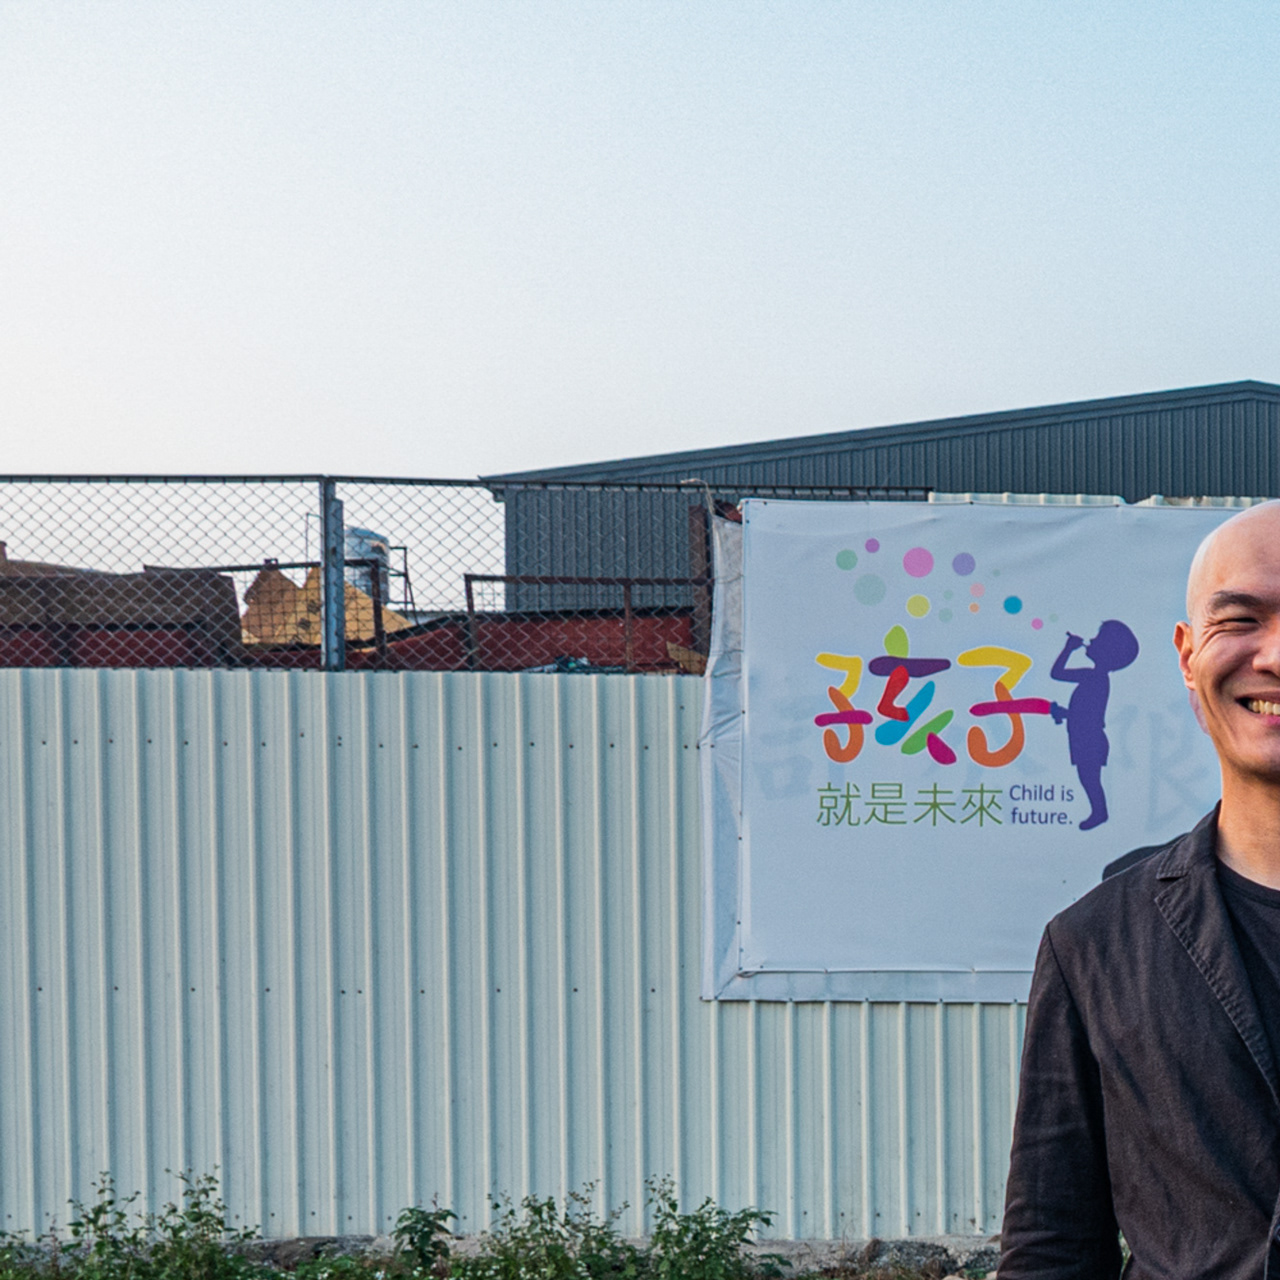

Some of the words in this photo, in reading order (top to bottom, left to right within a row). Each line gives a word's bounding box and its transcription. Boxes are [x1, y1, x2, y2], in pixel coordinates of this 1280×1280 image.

[813, 624, 1052, 768] 孩子
[816, 781, 1003, 828] 就是未來
[1009, 784, 1054, 801] Child
[1061, 784, 1075, 802] is
[1011, 806, 1073, 825] future.
